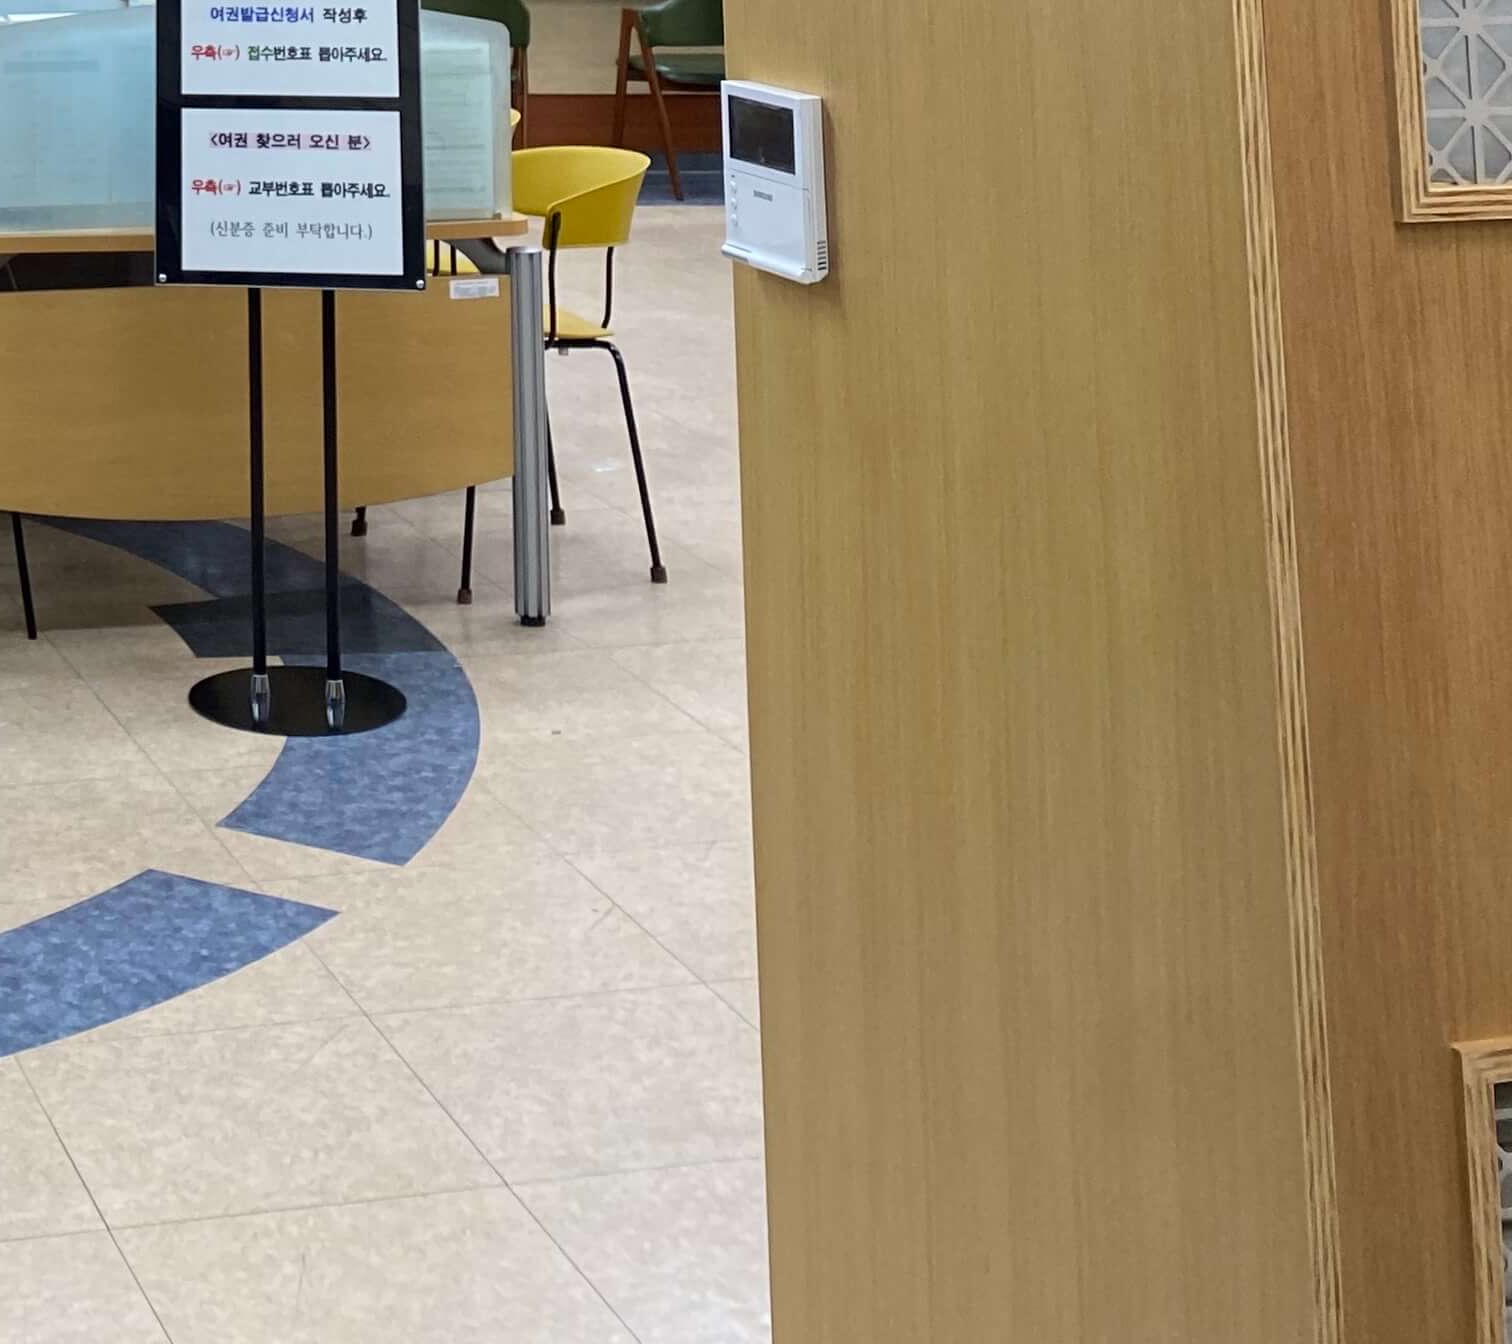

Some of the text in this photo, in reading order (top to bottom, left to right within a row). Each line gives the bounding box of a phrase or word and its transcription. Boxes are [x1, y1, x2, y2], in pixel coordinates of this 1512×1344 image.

[210, 6, 368, 24] 여권발급신청서 작성후
[248, 44, 313, 62] 접수번호표
[256, 132, 301, 150] 찾으러
[308, 133, 340, 150] 오신
[248, 180, 315, 198] 교부번호표
[262, 220, 289, 238] 준비
